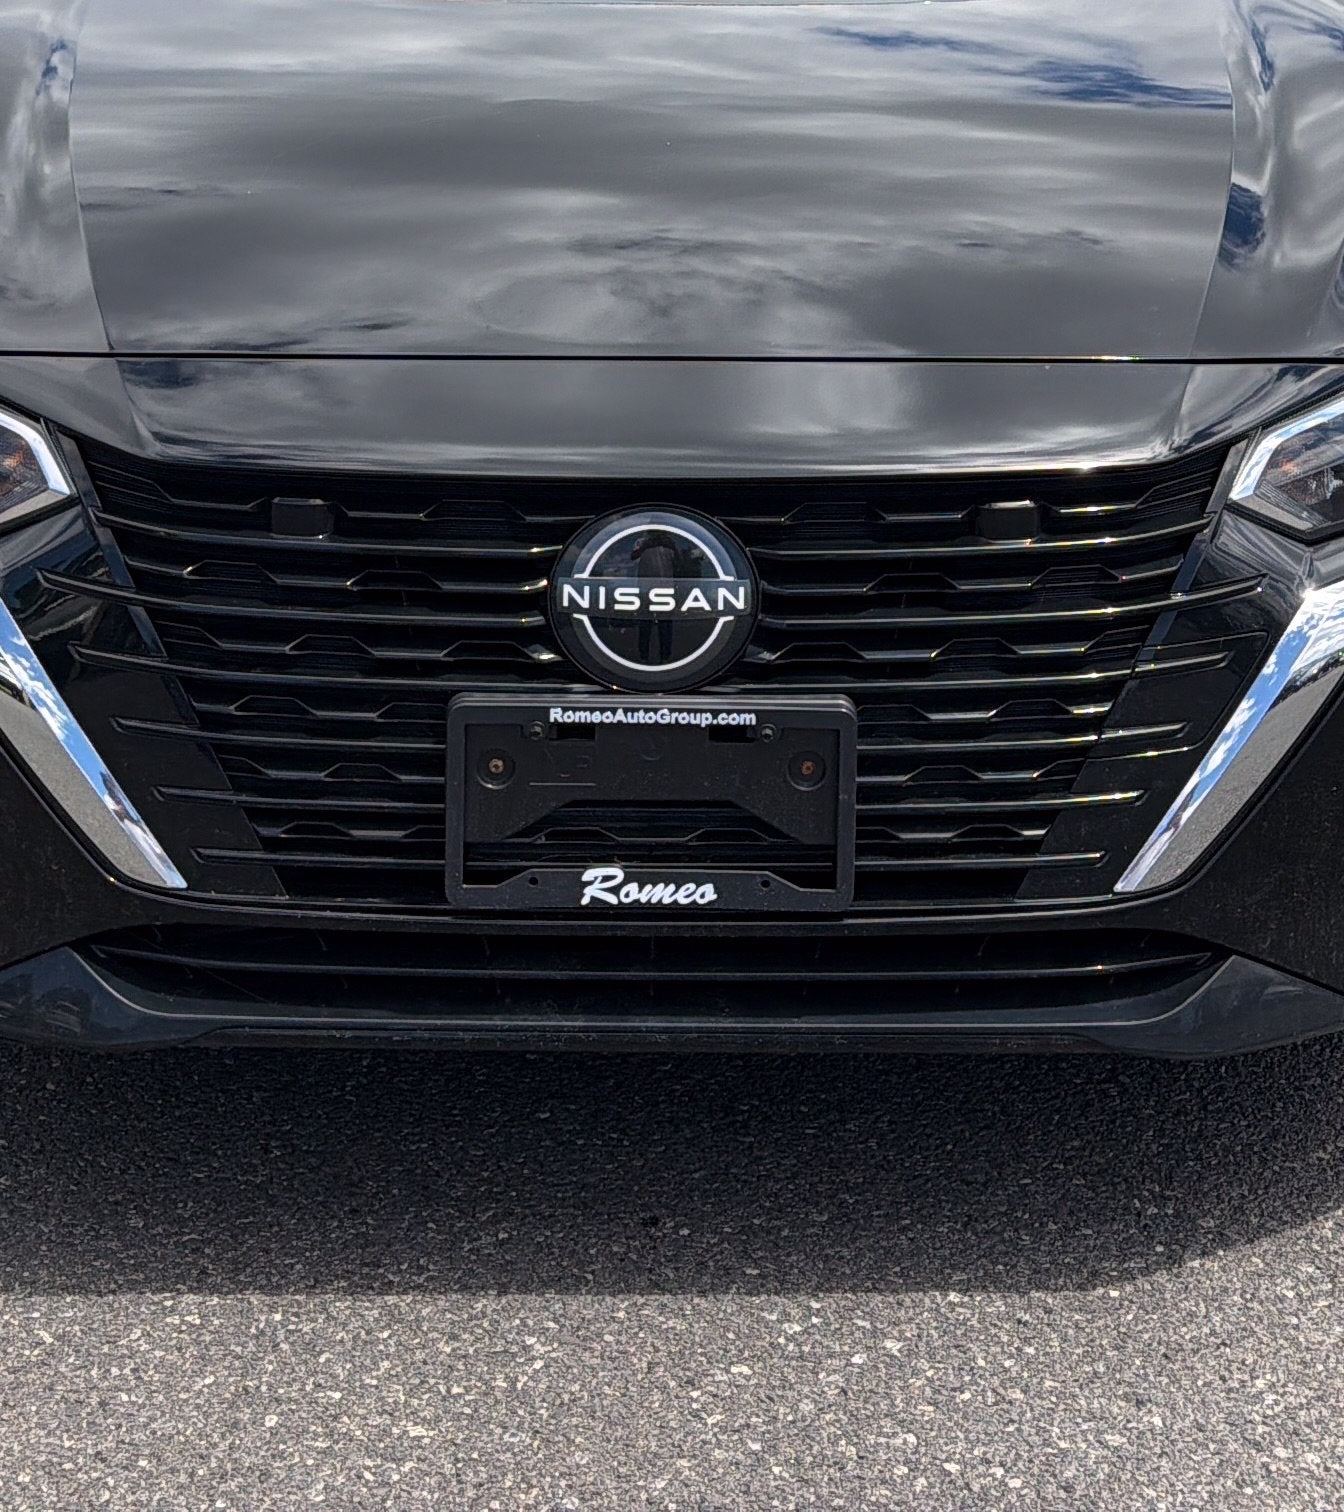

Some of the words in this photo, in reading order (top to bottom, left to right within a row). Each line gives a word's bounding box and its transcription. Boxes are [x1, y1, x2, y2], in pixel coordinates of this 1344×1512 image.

[562, 584, 745, 612] NISSAN
[549, 707, 756, 727] RomeoAutoGroup.com
[580, 867, 718, 905] Romeo
